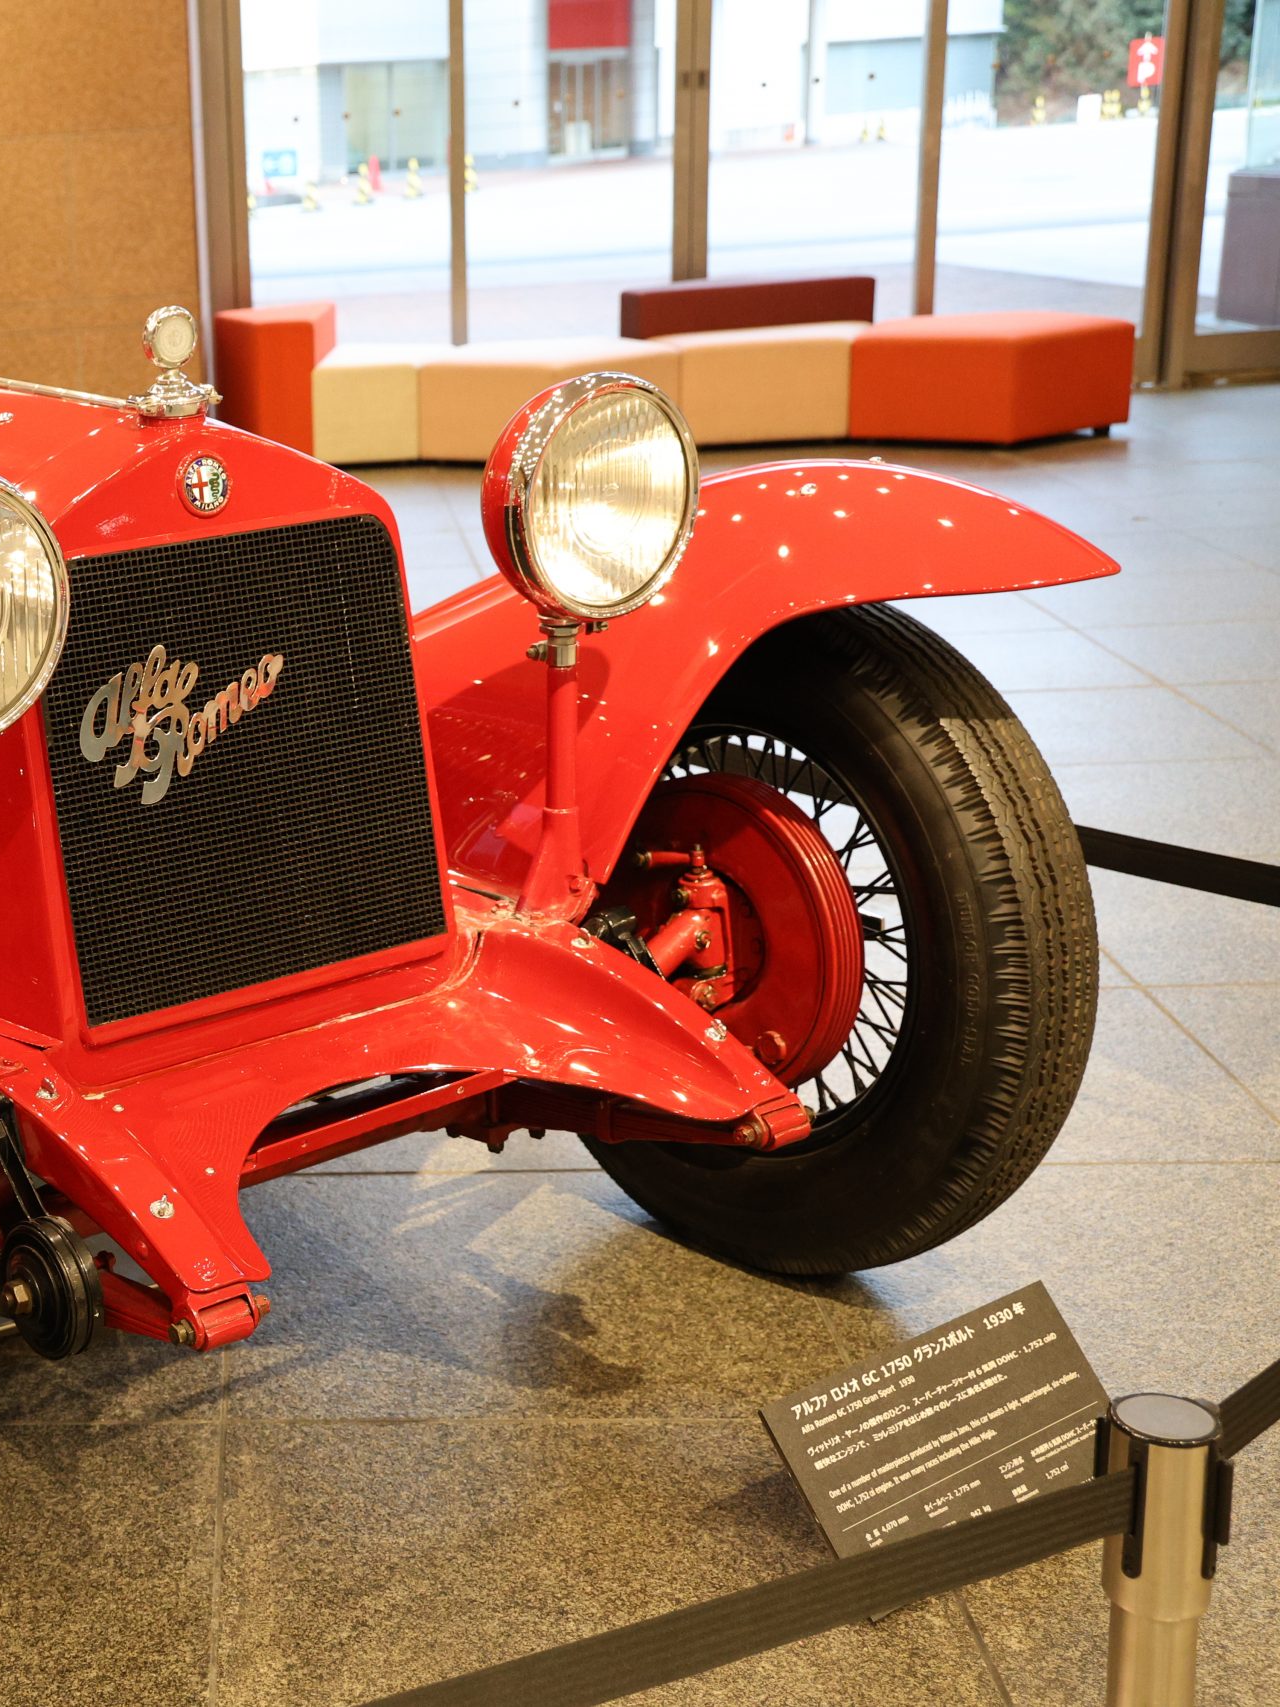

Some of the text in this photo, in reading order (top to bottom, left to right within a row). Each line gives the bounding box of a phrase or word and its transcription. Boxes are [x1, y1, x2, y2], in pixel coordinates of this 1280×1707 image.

[1137, 62, 1156, 84] P
[185, 459, 227, 485] ALFA ROMEO
[193, 496, 225, 511] MILANO
[135, 654, 284, 805] Romeo
[790, 1393, 828, 1421] アルファ
[829, 1377, 861, 1402] ロメオ
[861, 1369, 881, 1387] 6C
[879, 1354, 913, 1379] 1750
[801, 1374, 916, 1435] Alfa Romeo 6C 1750 Gran Sport 1930
[828, 1488, 842, 1499] One
[840, 1483, 848, 1494] of
[845, 1483, 853, 1491] a
[850, 1473, 872, 1489] number
[870, 1468, 879, 1479] of
[908, 1441, 934, 1461] produced
[930, 1439, 941, 1448] by
[969, 1418, 982, 1429] this
[979, 1415, 989, 1424] car
[1003, 1405, 1009, 1413] a
[835, 1499, 856, 1514] DOHC,
[853, 1490, 871, 1505] 1,752
[874, 1480, 895, 1495] engine.
[892, 1475, 901, 1485] It
[898, 1471, 912, 1482] won
[909, 1464, 927, 1477] many
[924, 1457, 940, 1470] races
[936, 1446, 963, 1463] including
[959, 1442, 971, 1452] the
[1045, 1467, 1062, 1480] 1,752
[953, 1483, 971, 1497] 2,775
[881, 1519, 899, 1533] 4,070
